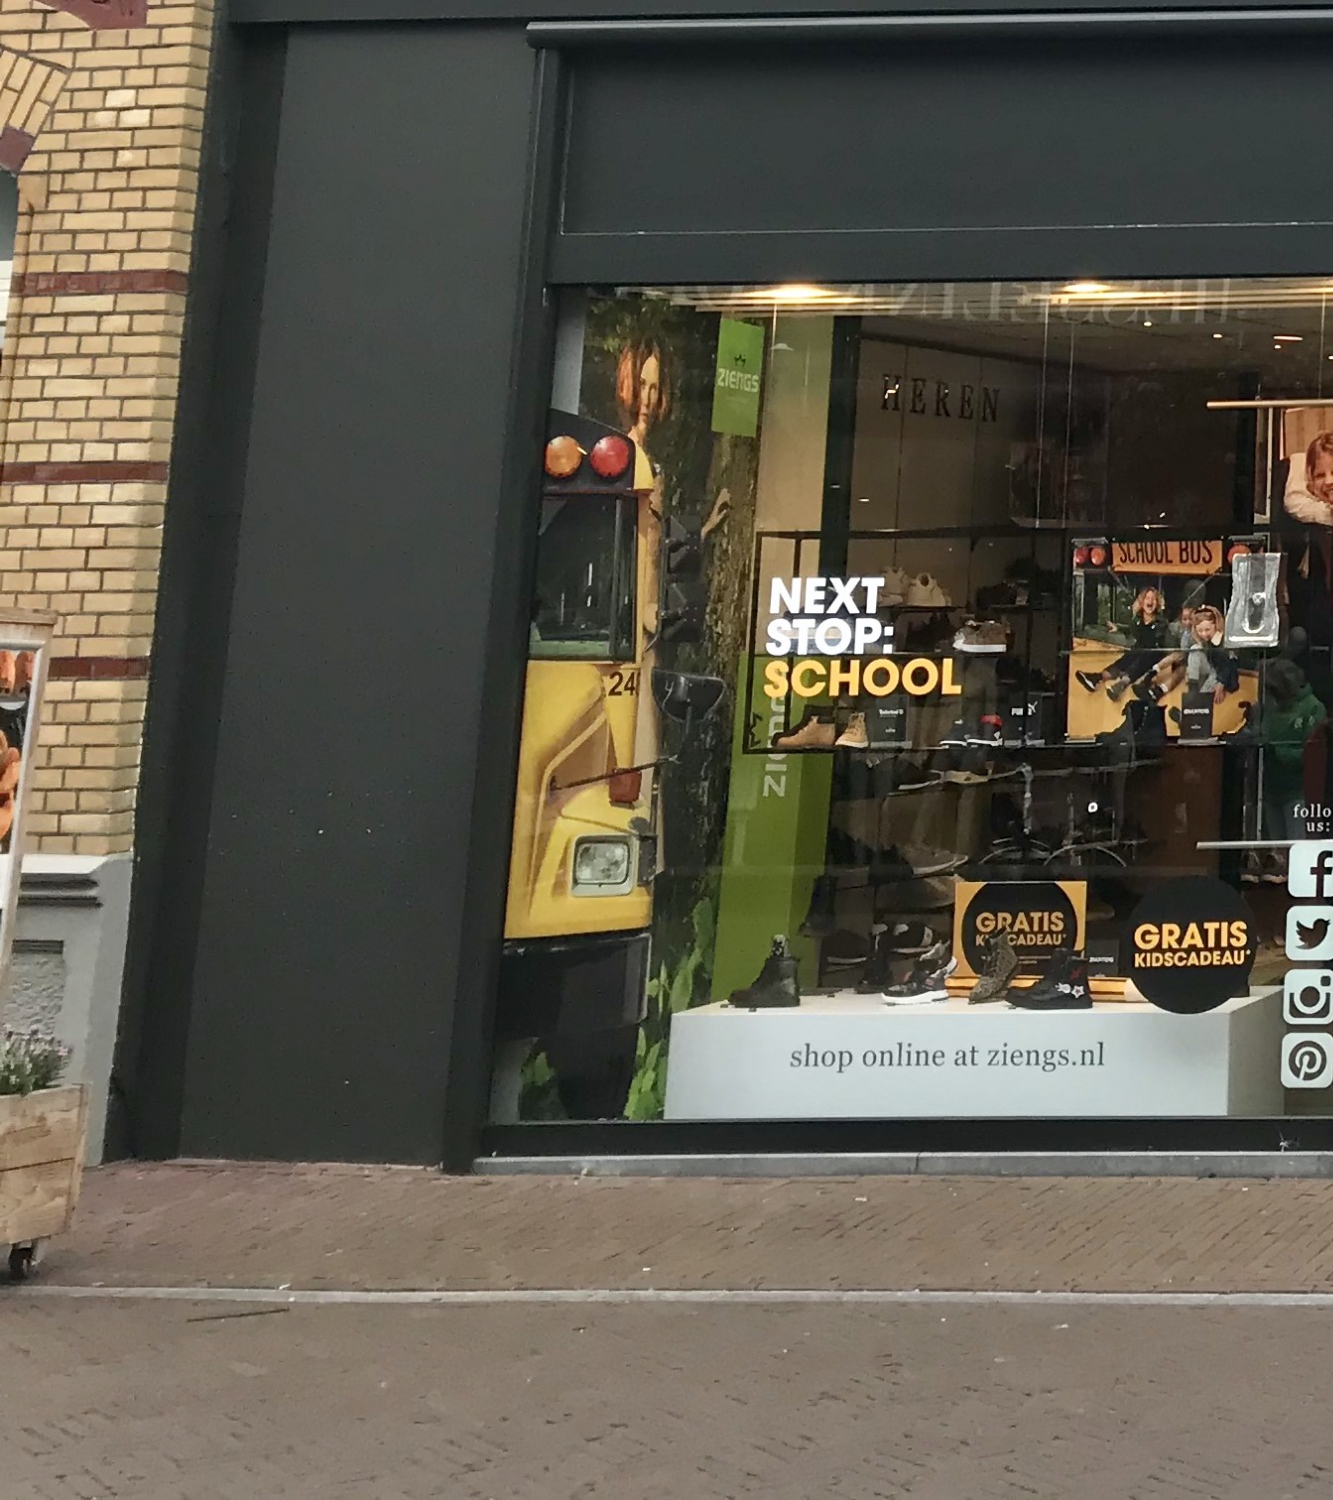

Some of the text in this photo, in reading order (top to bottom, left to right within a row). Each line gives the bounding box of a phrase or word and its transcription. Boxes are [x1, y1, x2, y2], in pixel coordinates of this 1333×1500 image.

[717, 367, 760, 394] ZIENGS
[881, 373, 1000, 422] HEREN
[1119, 540, 1213, 565] SCHOOL BUS
[769, 577, 885, 614] NEXT
[765, 617, 895, 656] STOP:
[608, 671, 636, 697] 24
[763, 657, 963, 698] SCHOOL
[1306, 820, 1331, 832] us:
[975, 911, 1064, 933] GRATIS
[1134, 921, 1247, 949] GRATIS
[790, 1042, 1105, 1073] shop online at ziengs.nl
